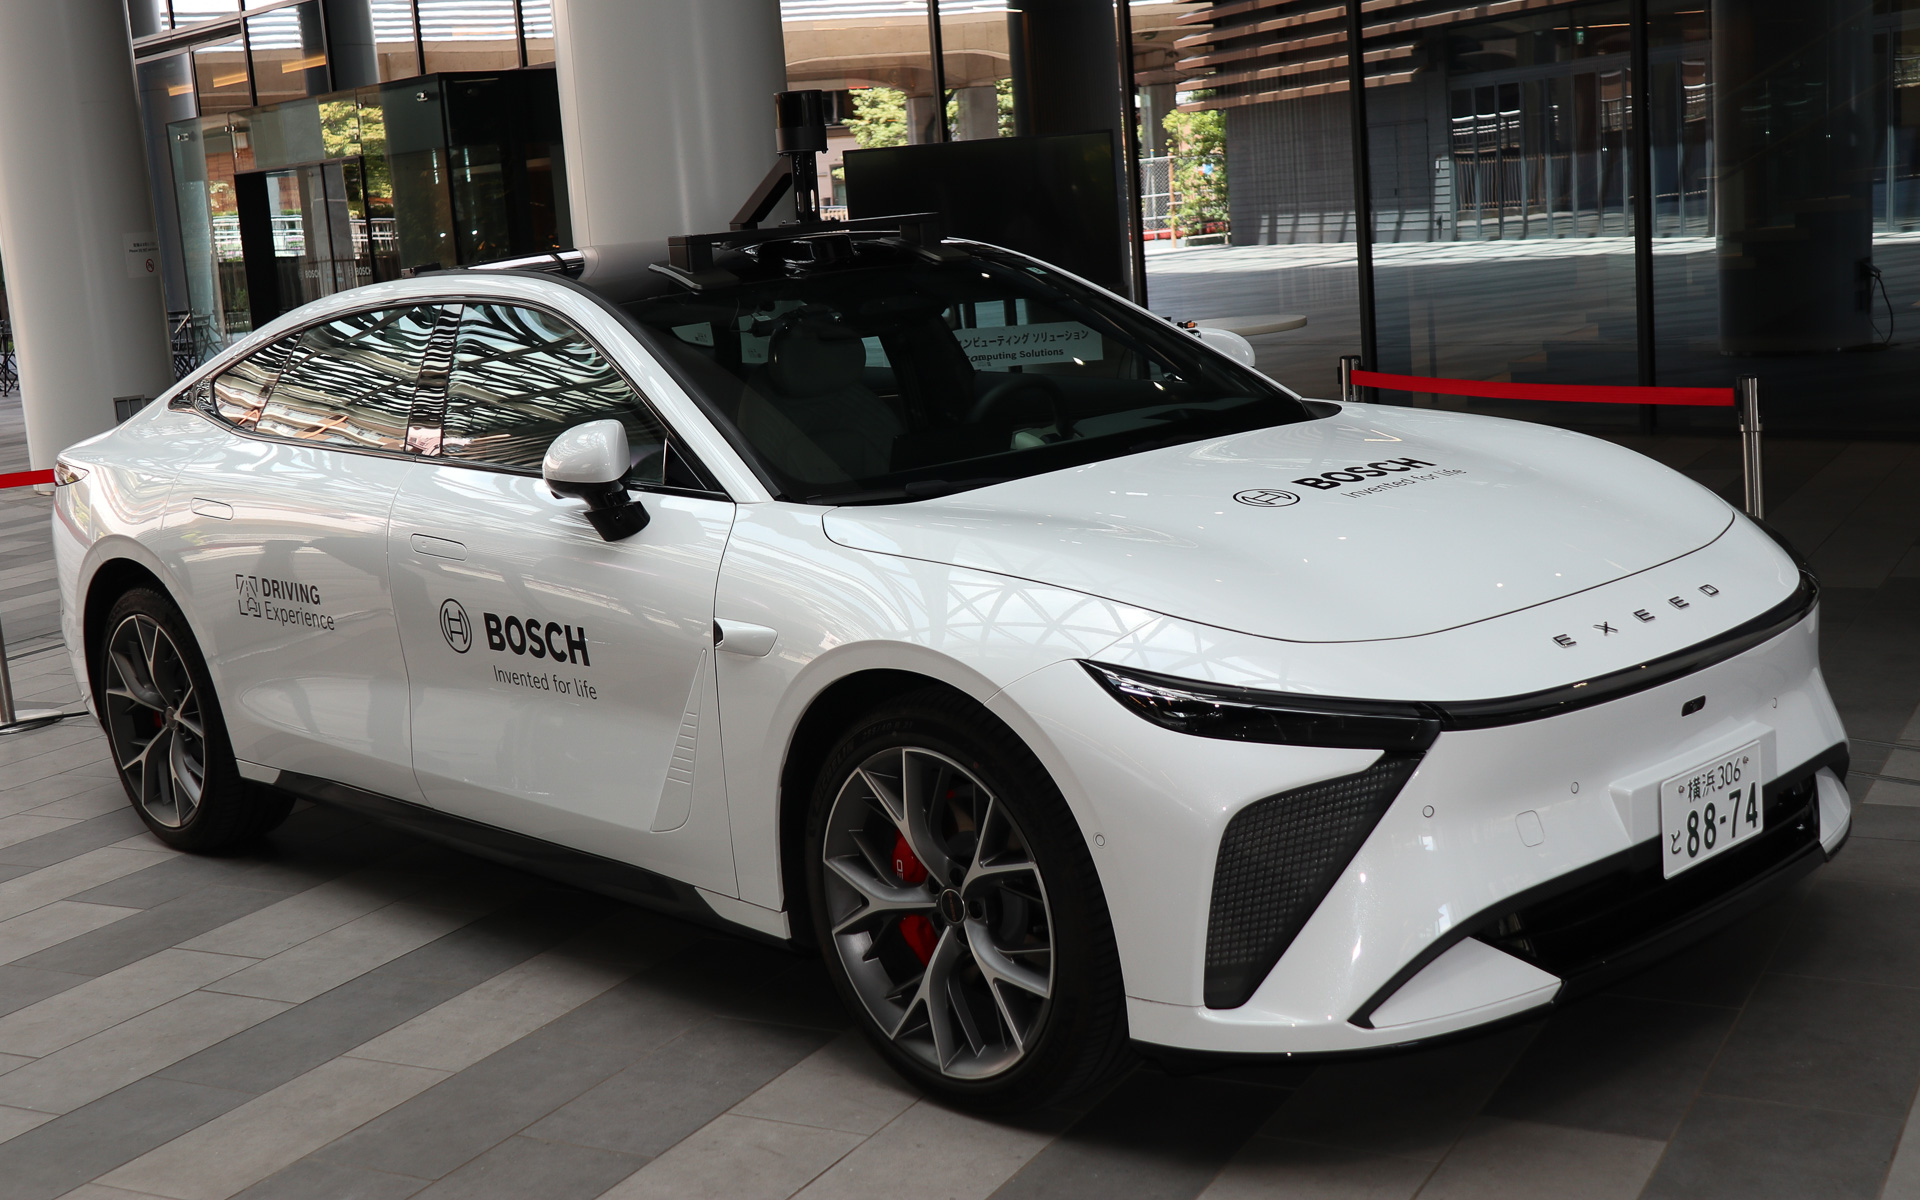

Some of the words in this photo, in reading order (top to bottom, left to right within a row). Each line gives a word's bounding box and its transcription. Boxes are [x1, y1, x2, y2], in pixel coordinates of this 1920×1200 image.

[960, 333, 1030, 349] ンピューティング
[968, 351, 1017, 362] omputing
[1019, 347, 1064, 359] Solutions
[1291, 457, 1437, 490] BOSCH
[1341, 478, 1417, 498] Invented
[261, 577, 321, 606] DRIVING
[264, 600, 335, 631] Experience
[1552, 584, 1719, 648] EXEED
[483, 612, 591, 667] BOSCH
[493, 665, 550, 692] Invented
[553, 674, 571, 695] for
[574, 678, 598, 701] life
[1686, 781, 1758, 858] 88-74
